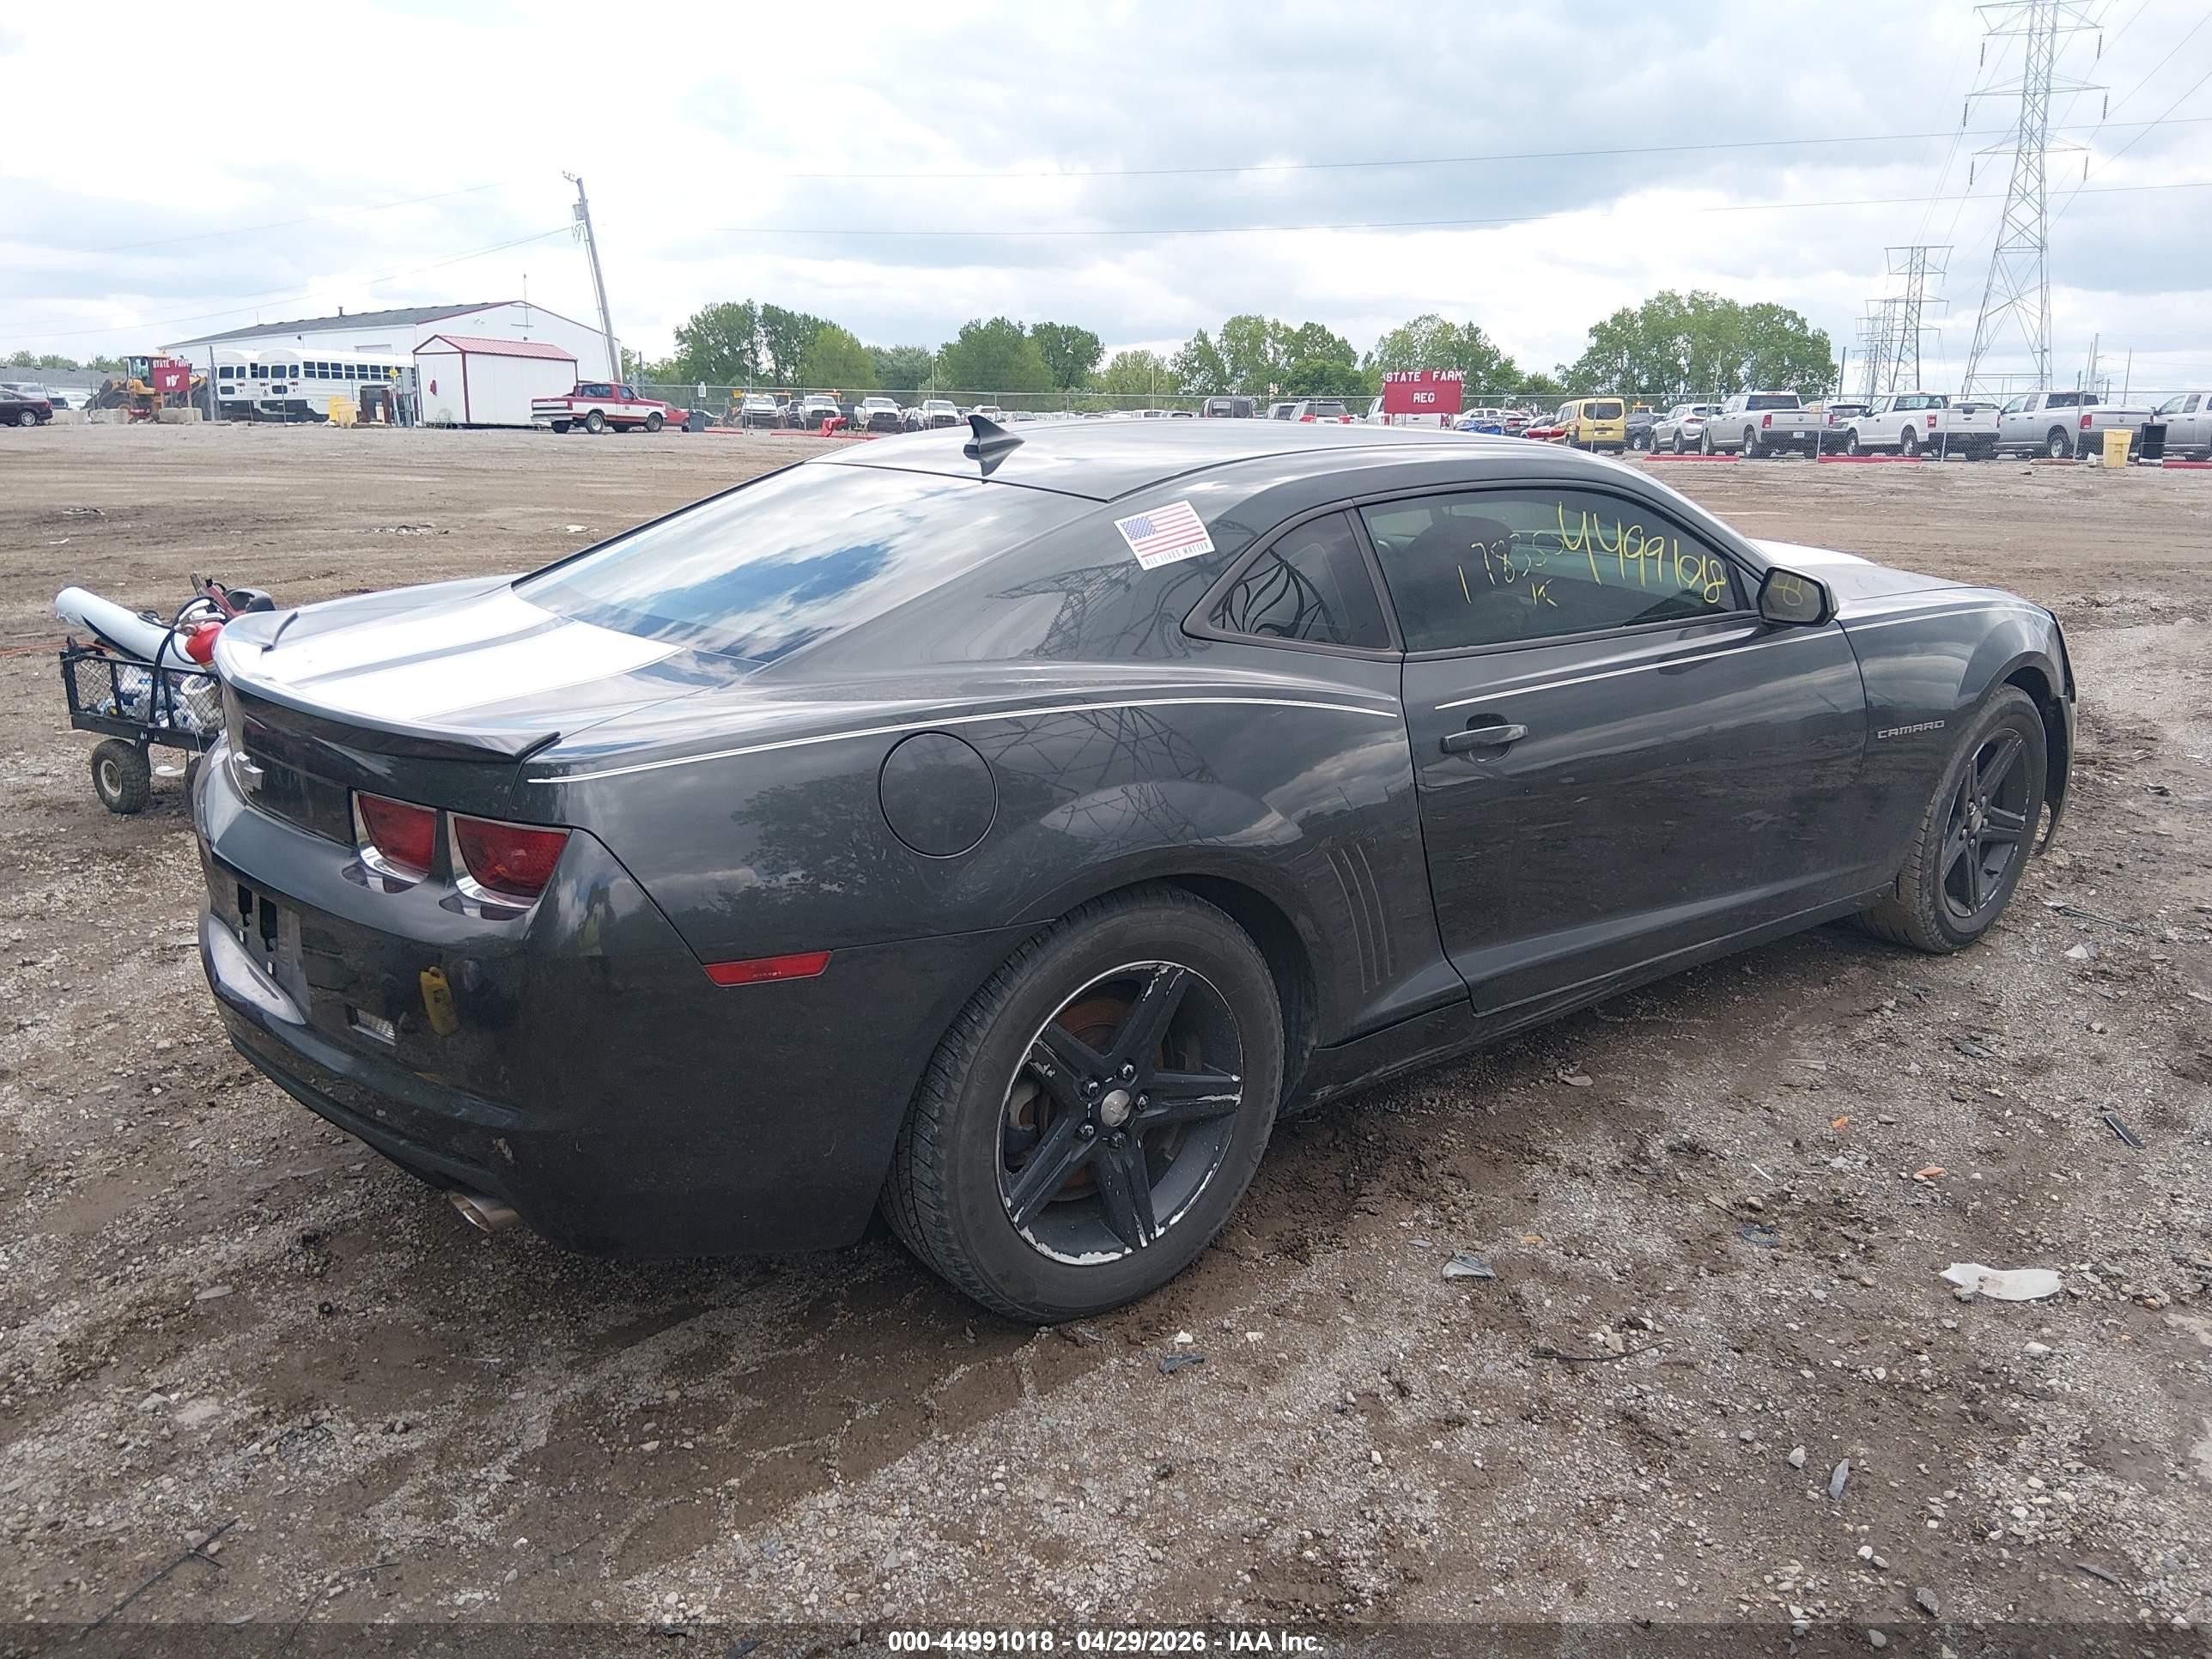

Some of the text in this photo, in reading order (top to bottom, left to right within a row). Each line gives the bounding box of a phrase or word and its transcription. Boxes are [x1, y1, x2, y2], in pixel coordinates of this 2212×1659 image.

[153, 359, 170, 368] STATE
[1386, 370, 1462, 382] STATE FARM
[1413, 392, 1435, 404] REG
[1159, 549, 1181, 562] LIVES
[1182, 541, 1210, 556] MATTER
[1877, 720, 1945, 738] CAMARO
